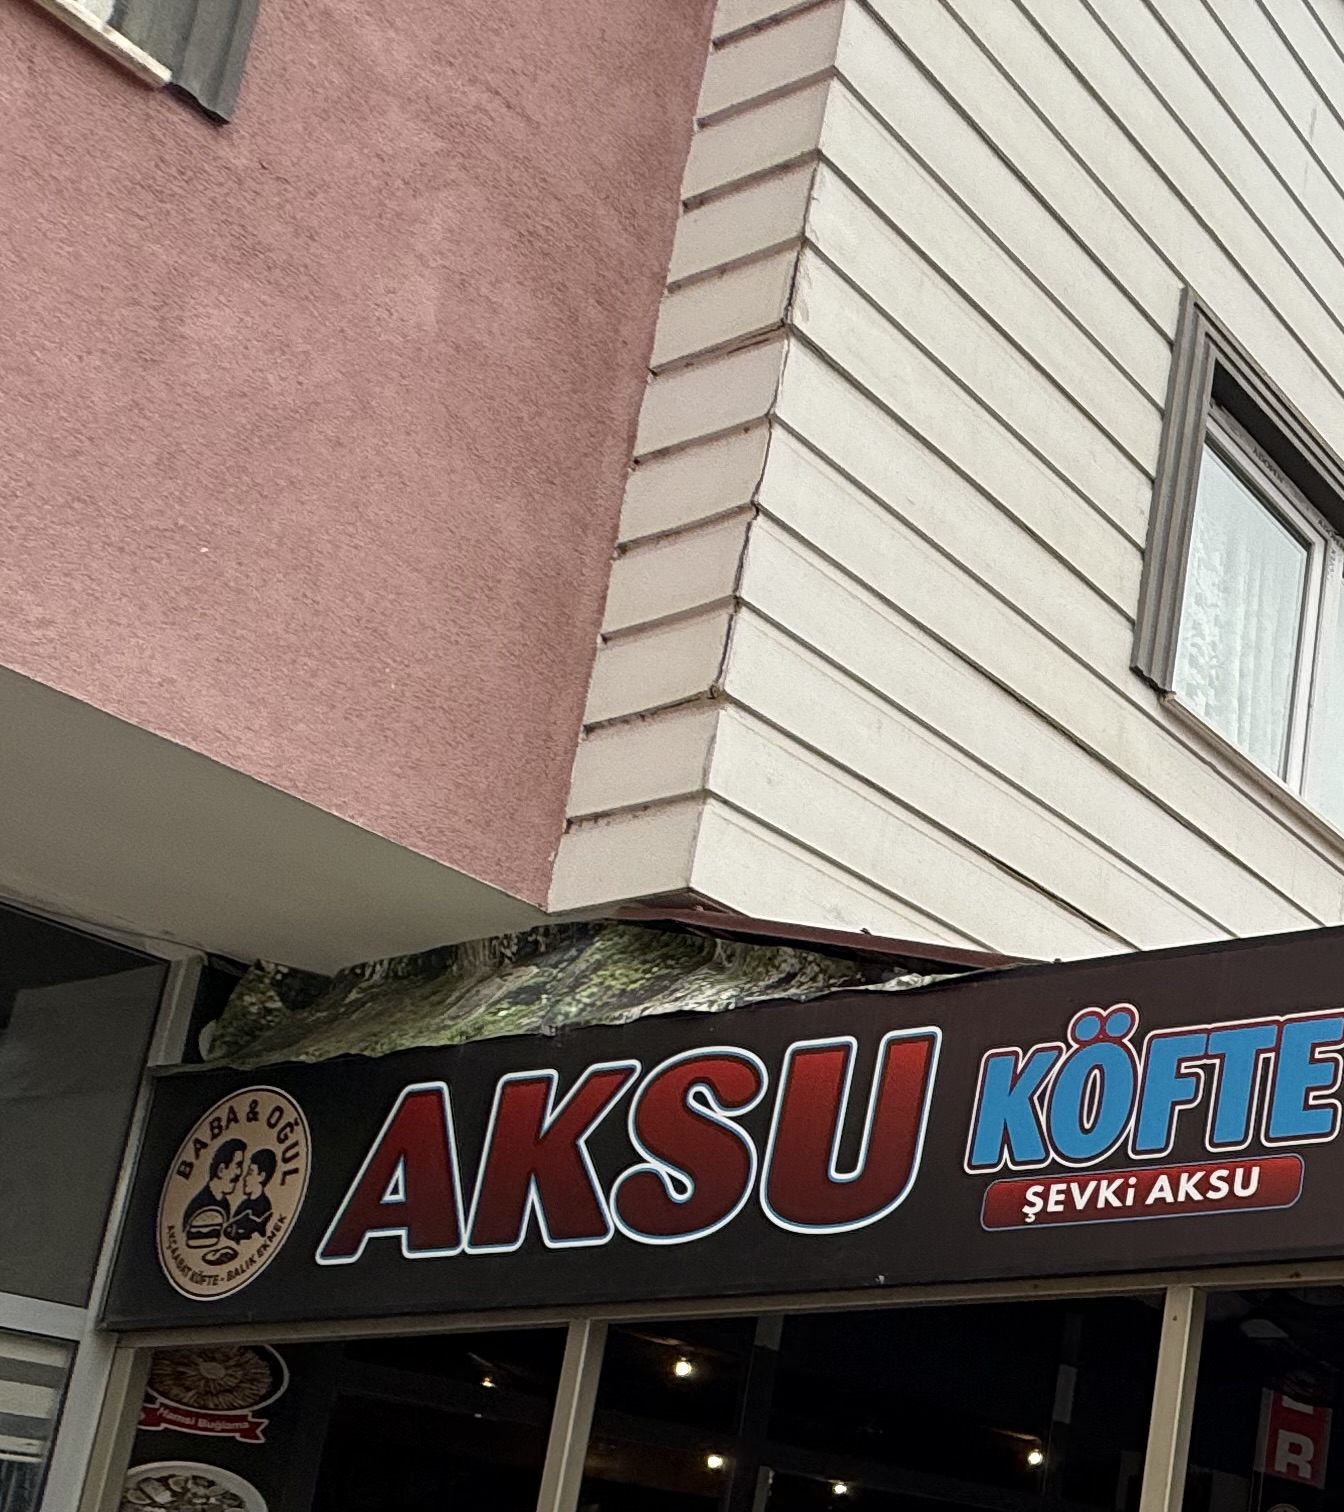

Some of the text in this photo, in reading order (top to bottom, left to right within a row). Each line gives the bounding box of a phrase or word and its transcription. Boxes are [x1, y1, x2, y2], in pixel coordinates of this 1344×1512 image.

[177, 1099, 300, 1186] BABA & OĞUL
[315, 1026, 942, 1265] AKSU
[1146, 1166, 1260, 1205] AKSU
